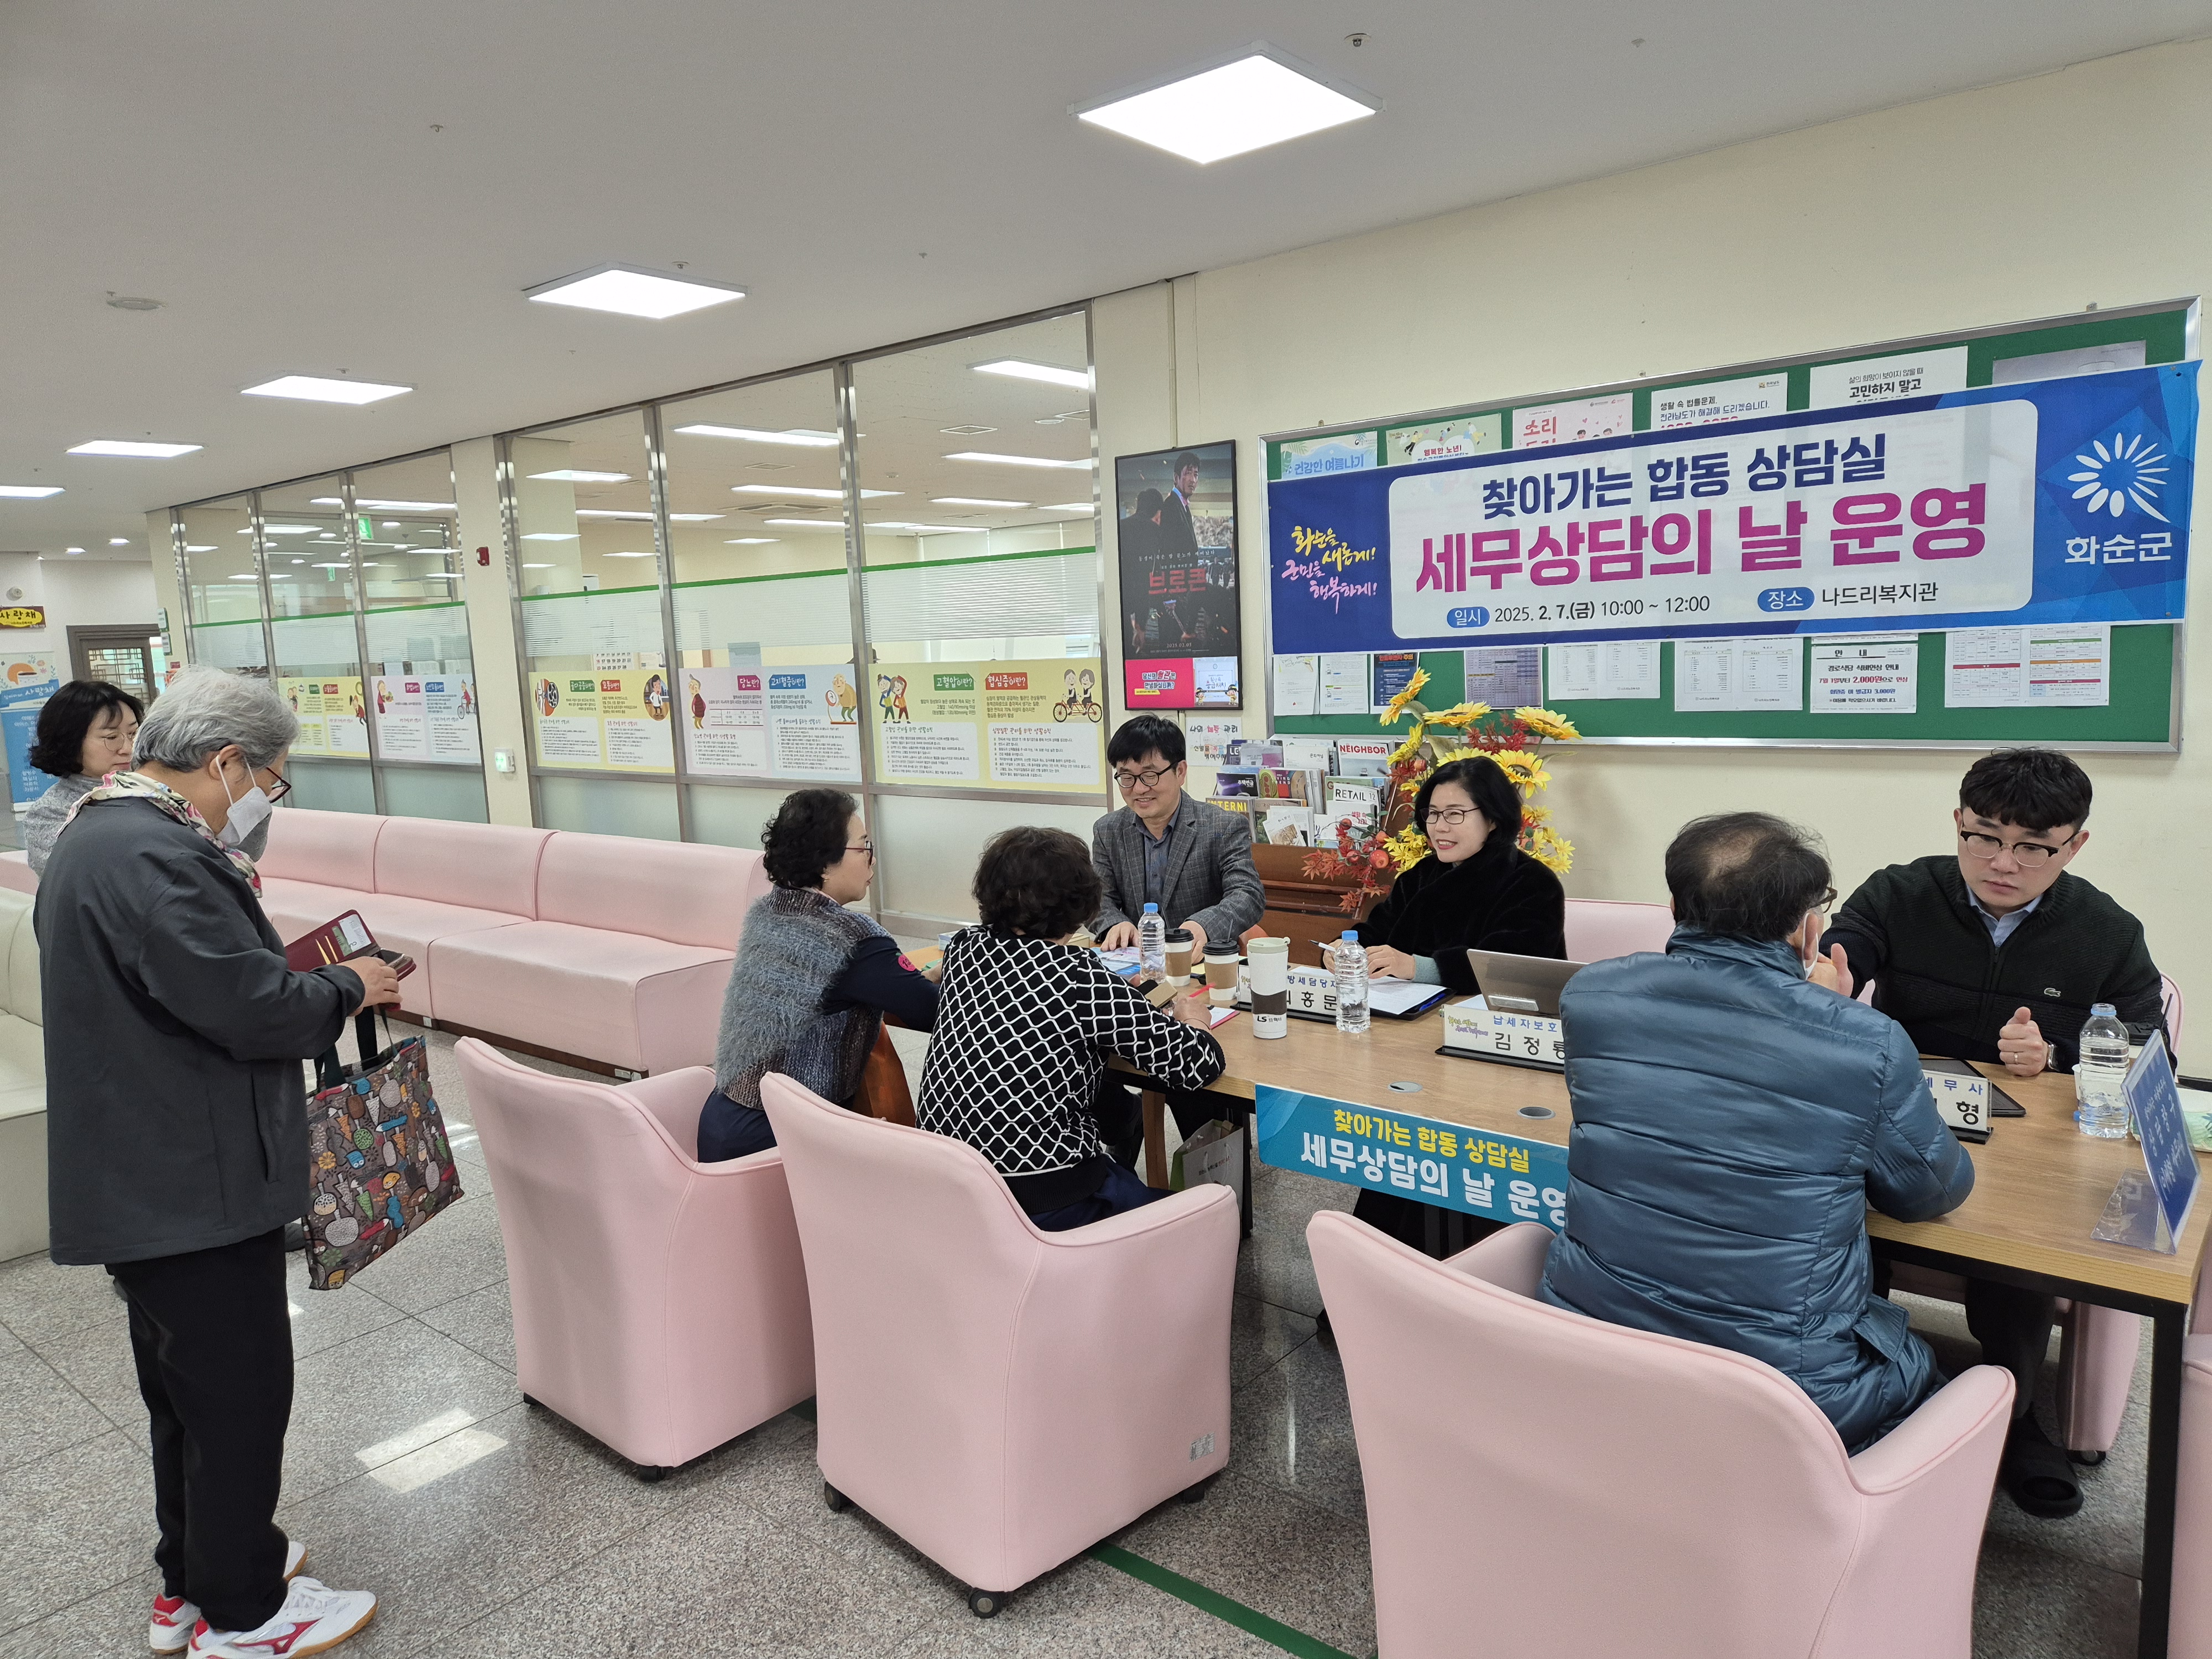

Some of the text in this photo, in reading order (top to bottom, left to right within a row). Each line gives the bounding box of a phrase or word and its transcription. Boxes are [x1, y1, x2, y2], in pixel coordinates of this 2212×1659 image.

[1849, 375, 1861, 384] 삶의
[1863, 373, 1881, 382] 희망이
[1882, 370, 1901, 379] 보이지
[1903, 368, 1916, 377] 않을
[1849, 382, 1895, 398] 고민하지
[1898, 378, 1922, 393] 말고
[1660, 401, 1674, 411] 생활
[1677, 400, 1684, 409] 속
[1660, 400, 1770, 422] 전라남도가 해결해 드리겠습니다.
[1523, 416, 1557, 436] 소리
[1423, 447, 1444, 457] 행복한
[1294, 453, 1364, 475] 건강한 여름나기
[1483, 433, 1886, 519] 찾아가는 합동 상담실
[1291, 526, 1339, 556] 화순을
[1416, 483, 1986, 593] 세무상담의 날 운영
[1322, 542, 1376, 572] 새롭게!
[2065, 532, 2172, 566] 화순군
[1281, 559, 1326, 581] 군민을
[1149, 568, 1207, 594] 브로큰
[1310, 576, 1378, 614] 행복하게!
[1767, 582, 1938, 610] 장소 나드리복지관
[1454, 609, 1483, 626] 일시
[1495, 607, 1534, 623] 2025.
[1556, 602, 1595, 621] 7.(금)
[1601, 599, 1644, 616] 10:00
[1665, 596, 1710, 613] 12:00
[739, 677, 759, 688] 당뇨란?
[771, 676, 804, 687] 고지혈증이란?
[936, 677, 972, 688] 고혈압이란?
[987, 675, 1026, 688] 협심증이란?
[1157, 670, 1176, 680] 혈관은
[25, 686, 55, 696] 사랑채
[1144, 681, 1175, 690] 안녕하십니까?
[1223, 724, 1238, 733] 관리
[1339, 744, 1387, 754] NEIGHBOR
[1335, 788, 1376, 801] RETAIL 12
[1493, 1015, 1558, 1032] 납세자보호
[1334, 1109, 1530, 1173] 찾아가는 합동 상담실
[1301, 1131, 1448, 1198] 세무상담의
[1463, 1168, 1495, 1208] 날
